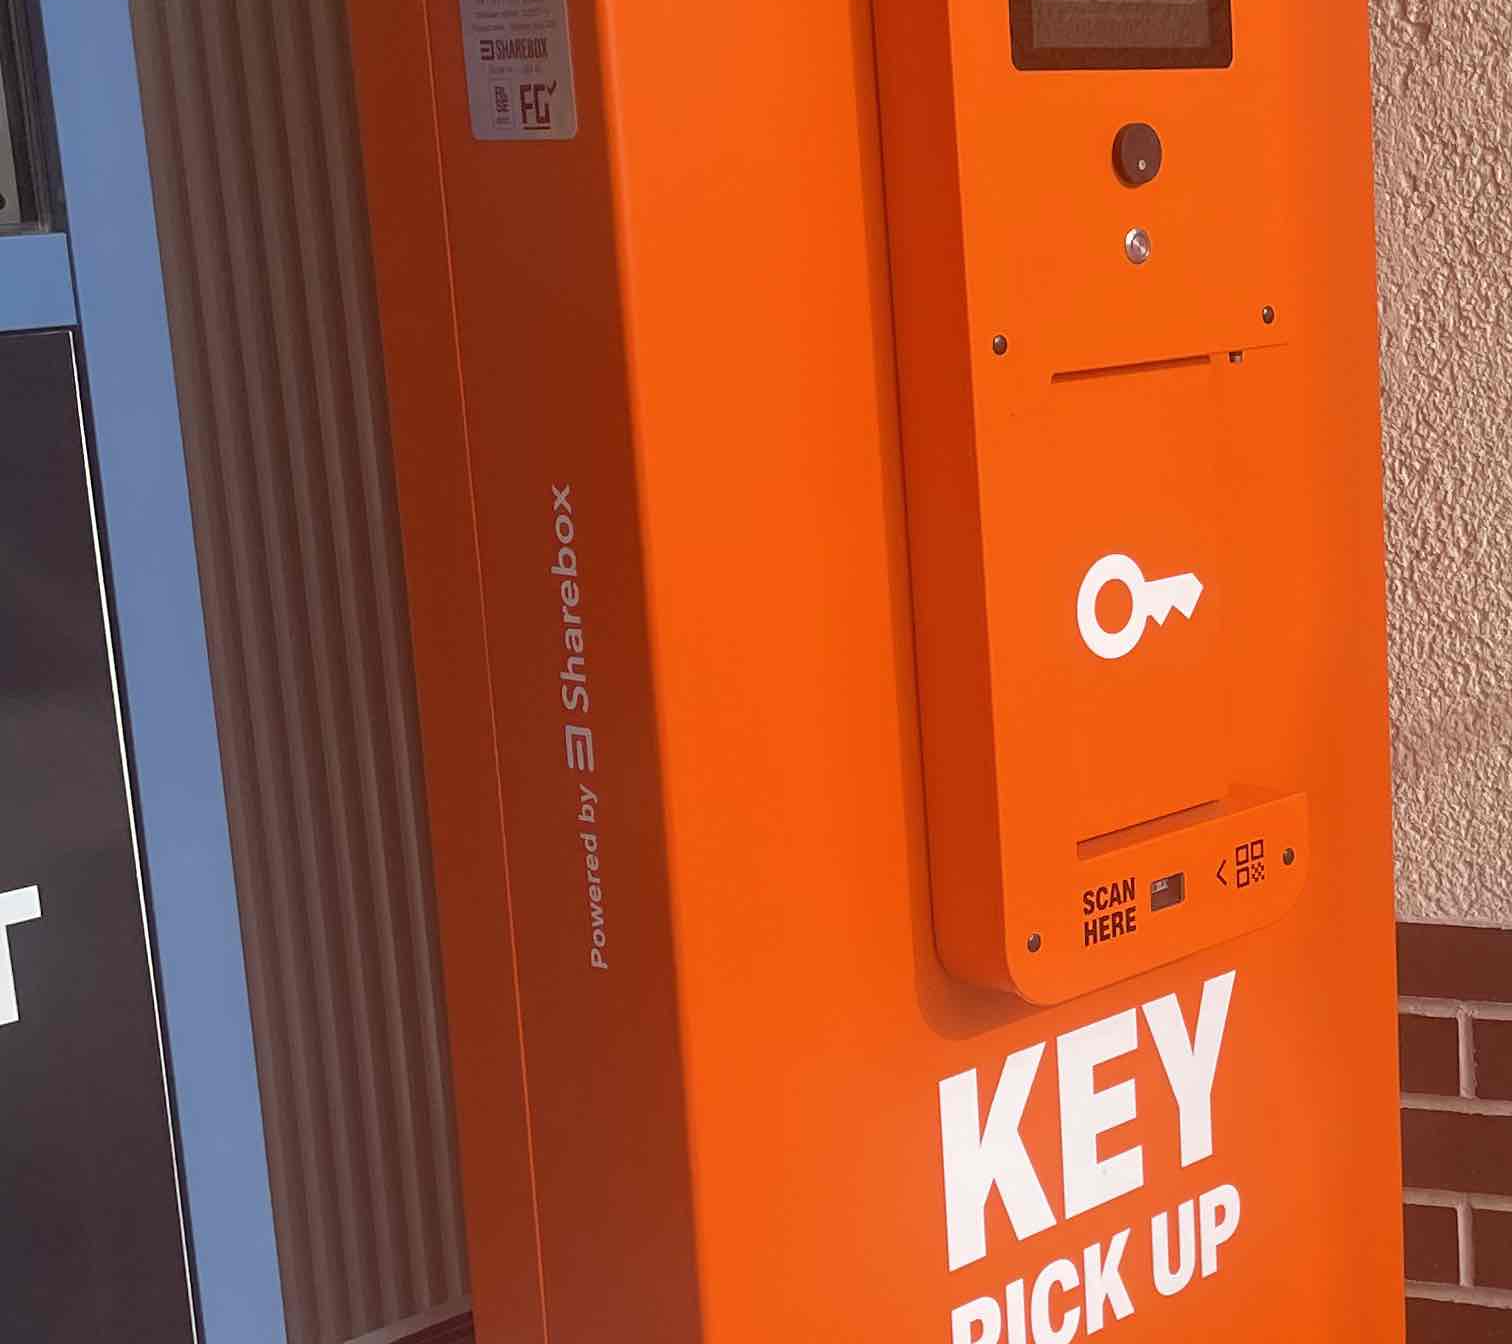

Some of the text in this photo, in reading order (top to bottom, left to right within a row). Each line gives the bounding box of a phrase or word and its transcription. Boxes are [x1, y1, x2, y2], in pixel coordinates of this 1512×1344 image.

[496, 38, 549, 61] SHAREBOX
[551, 483, 609, 970] Powered by Sharebox
[1082, 877, 1136, 916] SCAN
[1083, 906, 1137, 946] HERE
[938, 969, 1237, 1273] KEY
[1151, 1183, 1242, 1296] UP
